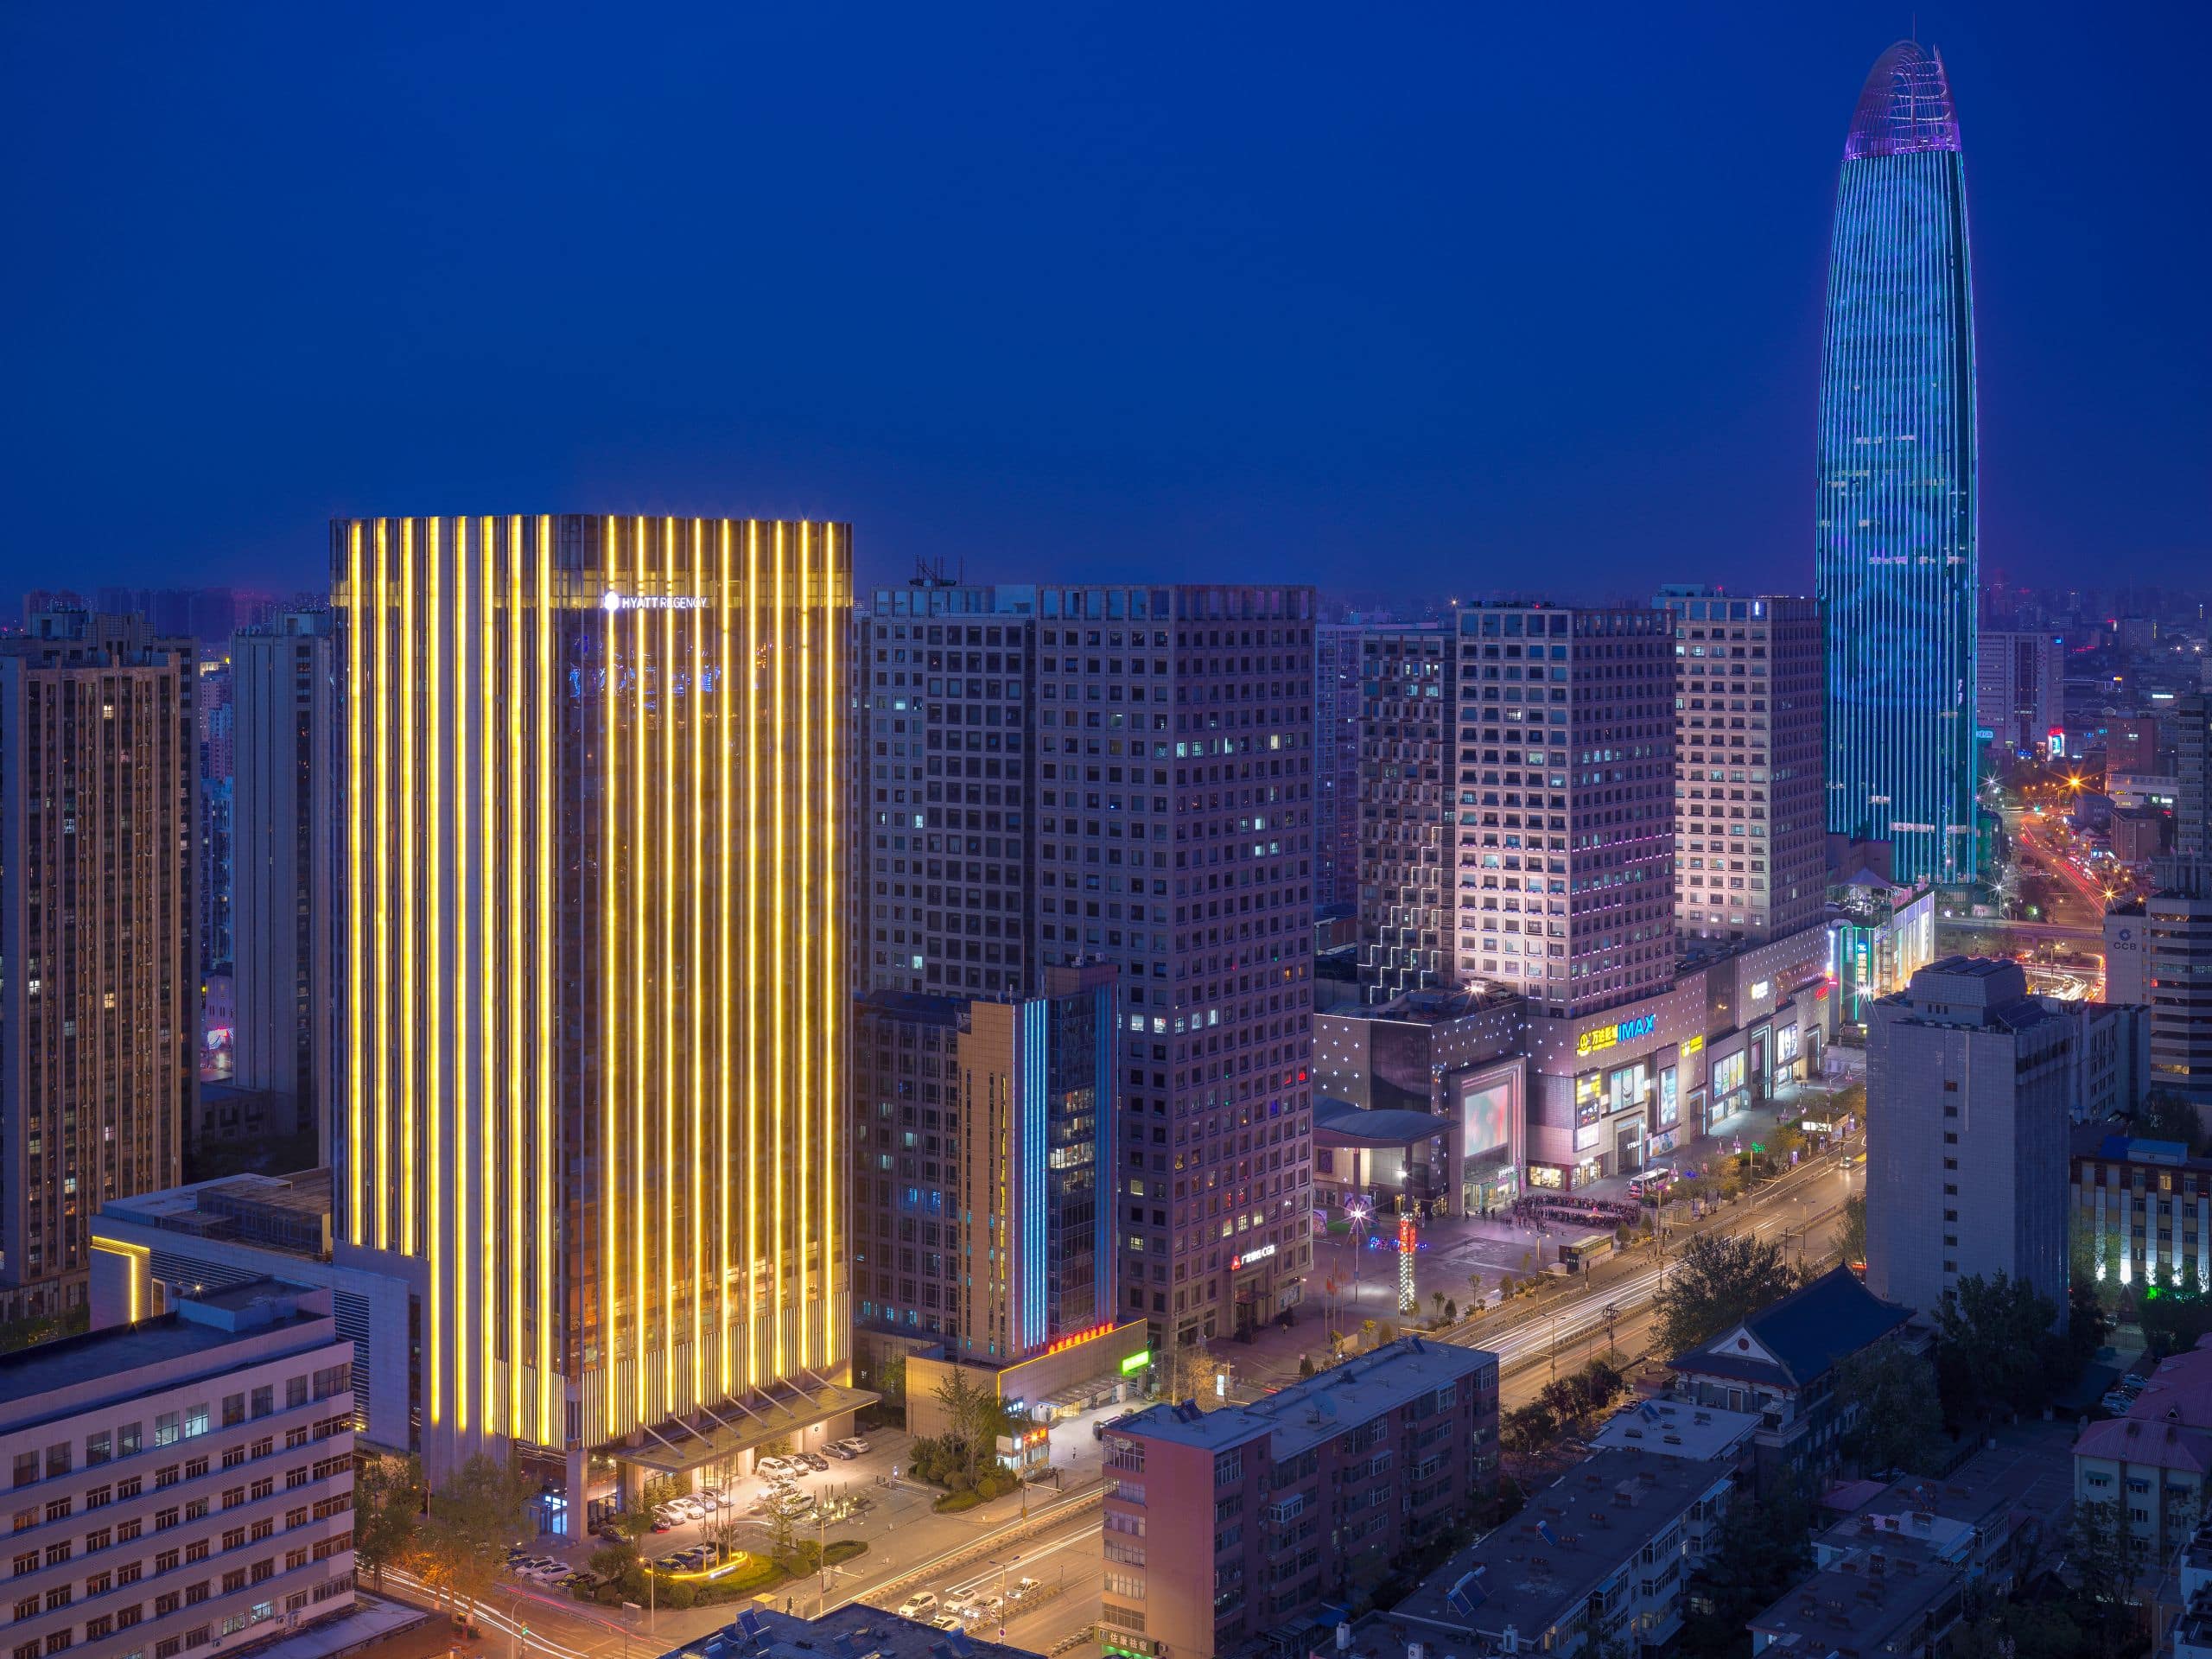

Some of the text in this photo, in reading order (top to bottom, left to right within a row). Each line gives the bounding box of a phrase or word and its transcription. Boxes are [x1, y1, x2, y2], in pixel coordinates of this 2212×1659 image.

[622, 597, 708, 609] HYATT REGENCY
[2113, 942, 2137, 950] CCB
[1618, 1014, 1656, 1042] IMAX
